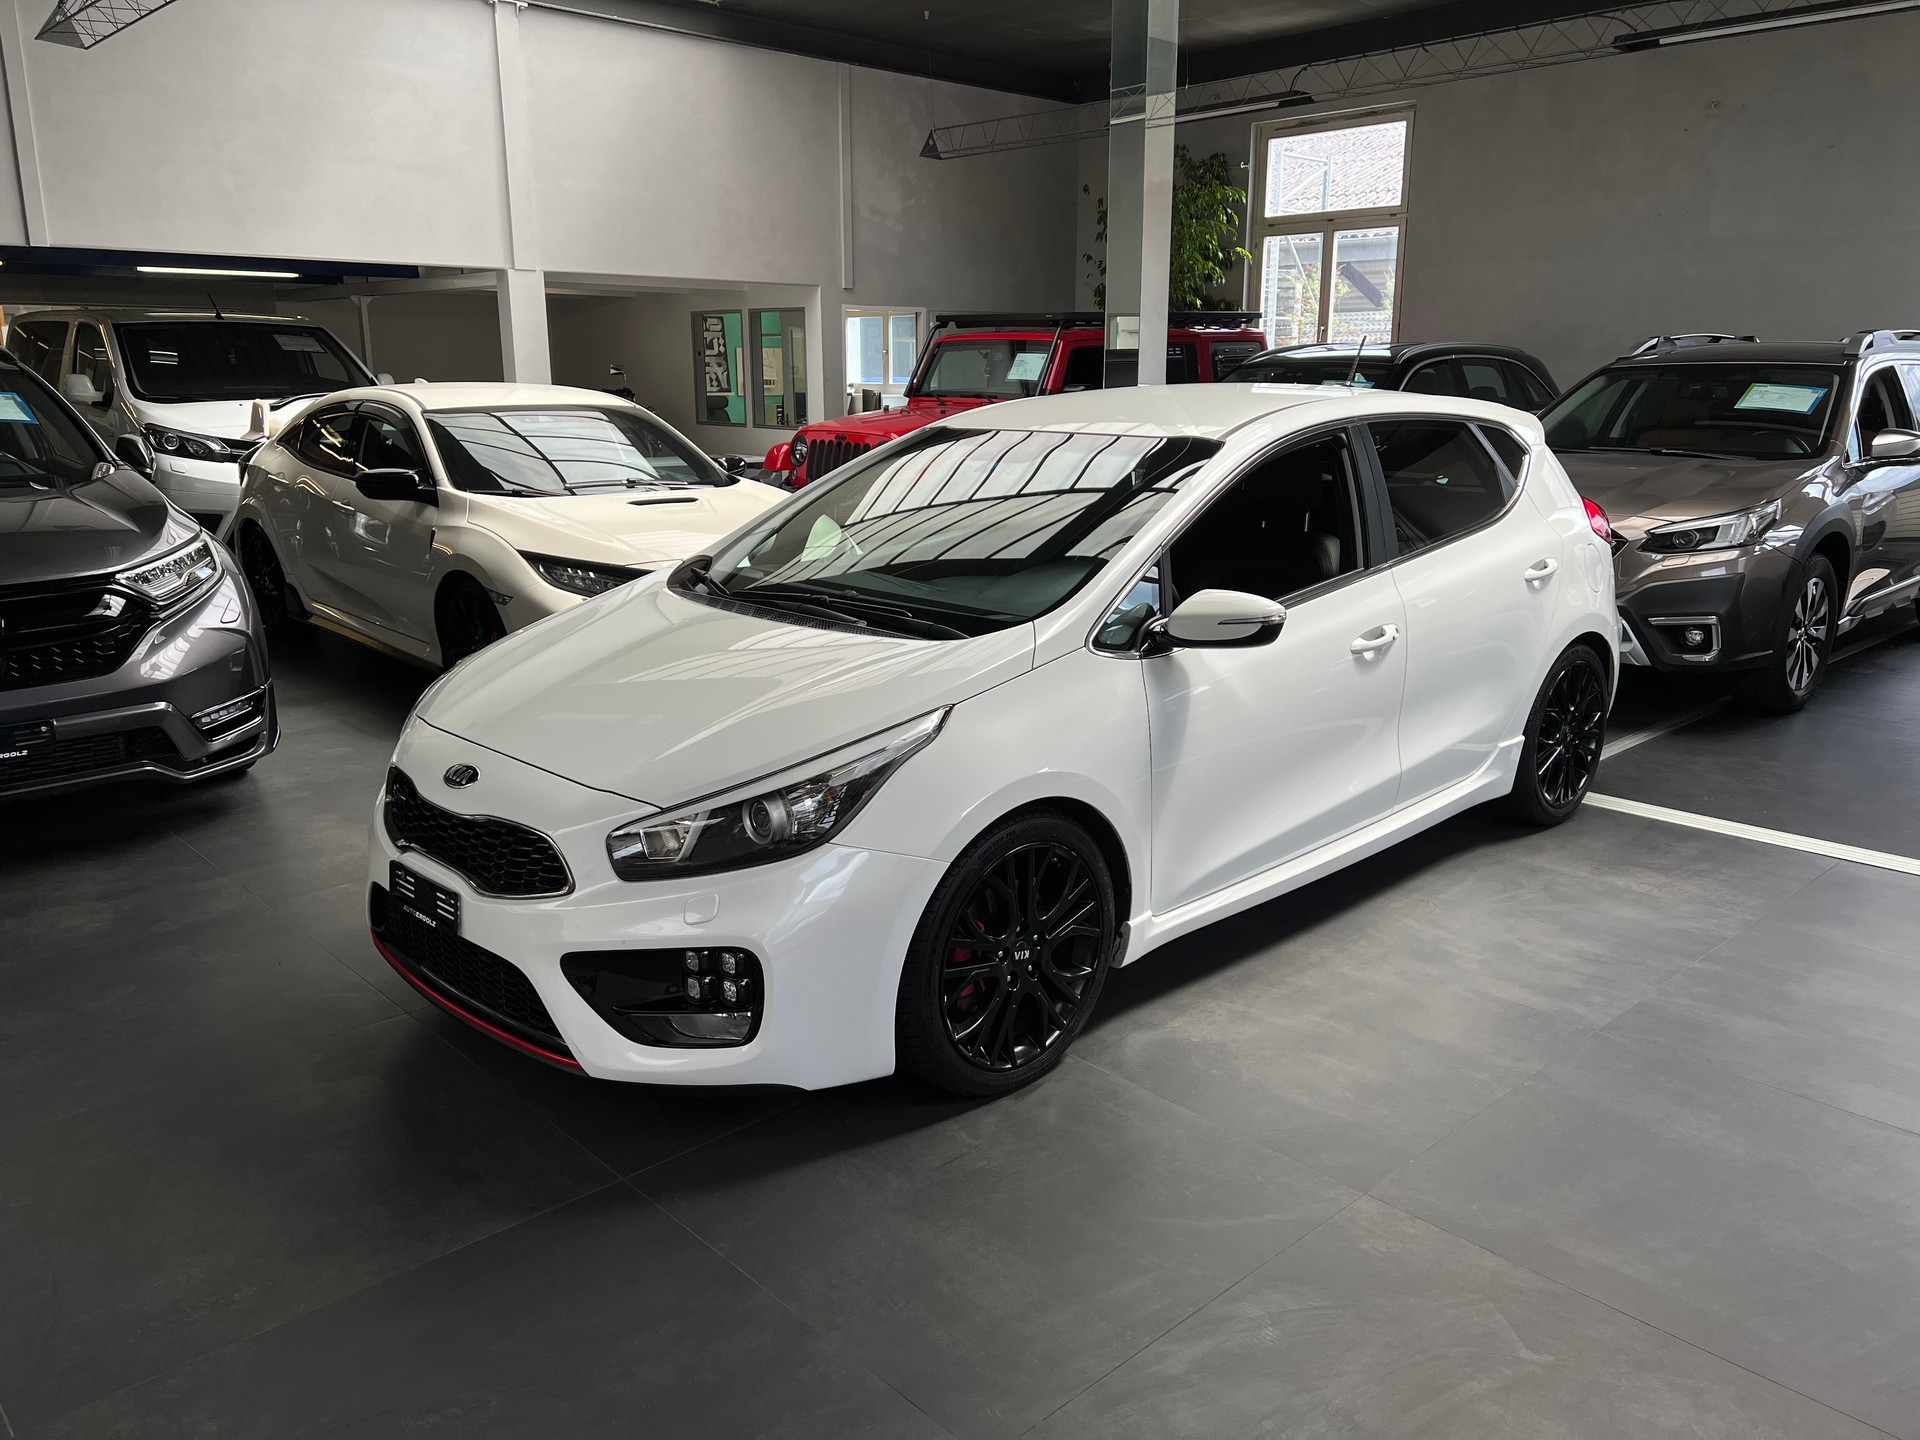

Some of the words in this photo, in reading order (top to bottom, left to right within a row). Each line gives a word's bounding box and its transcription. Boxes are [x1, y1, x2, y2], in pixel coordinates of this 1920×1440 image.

[445, 764, 474, 785] KIA
[402, 904, 437, 928] AUTOERGOLZ
[1014, 949, 1030, 960] KIA
